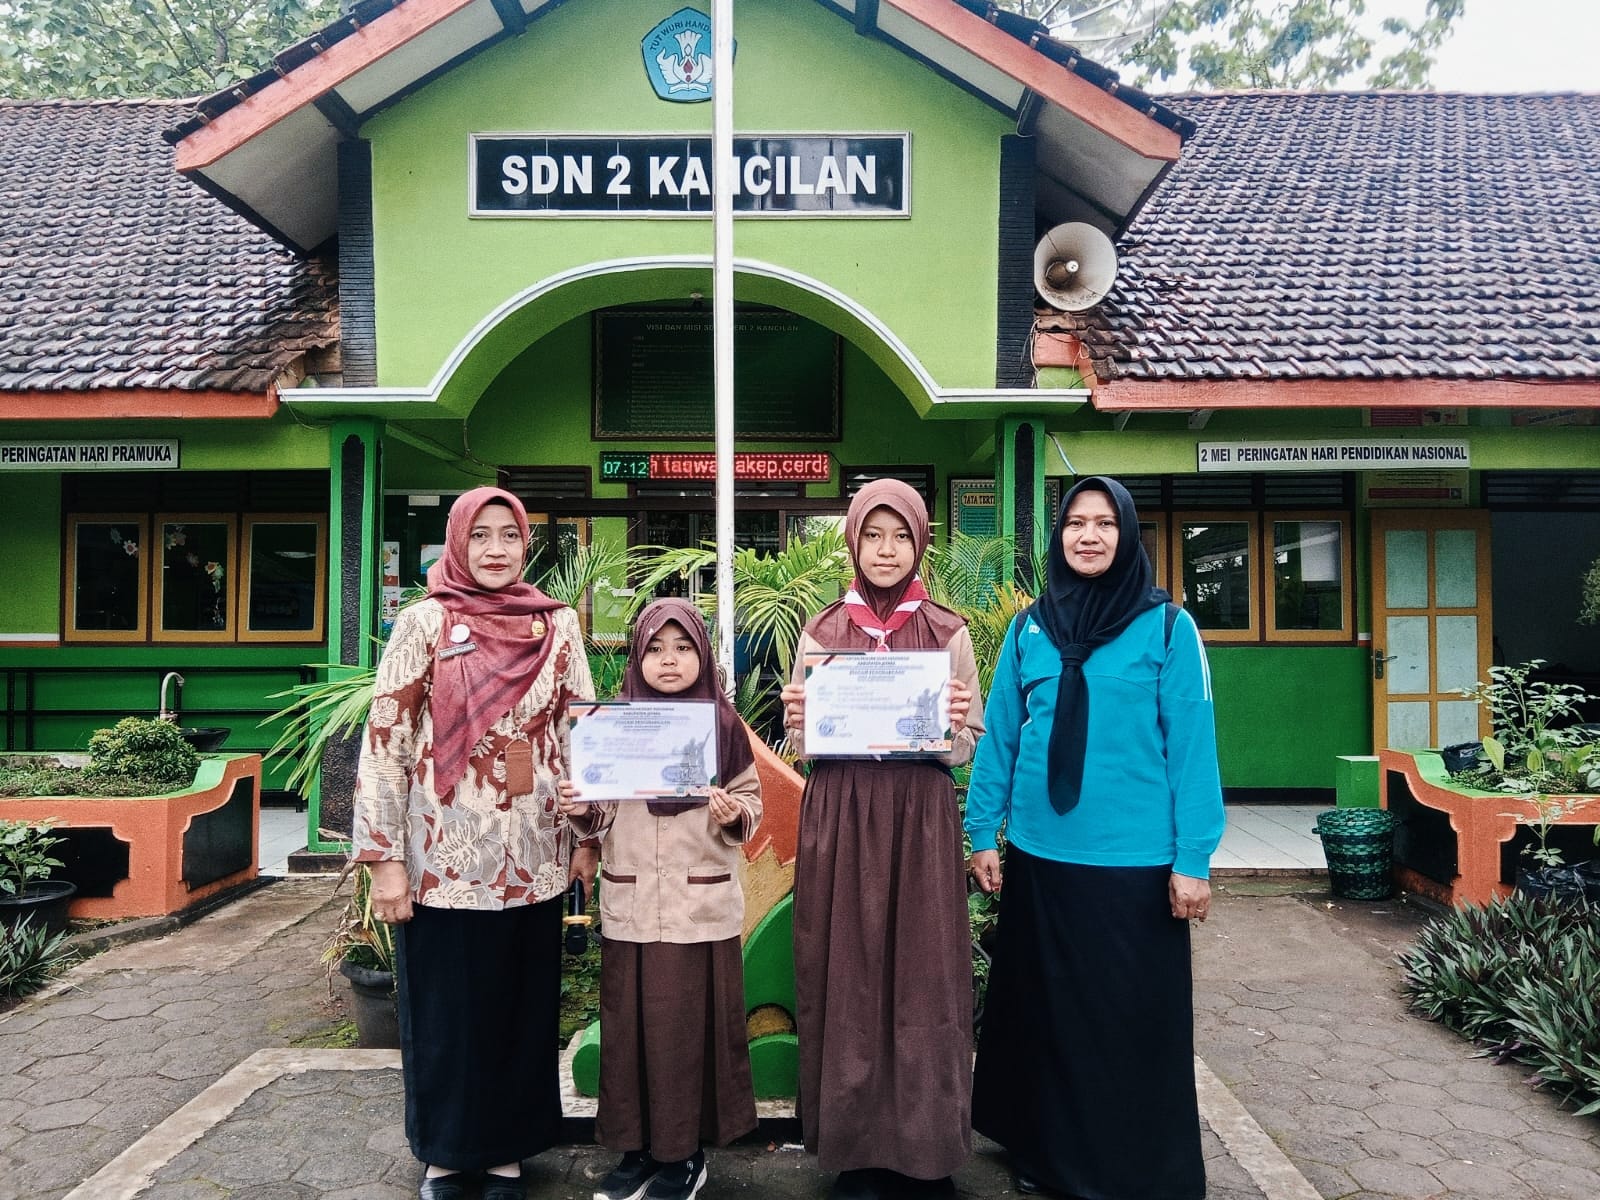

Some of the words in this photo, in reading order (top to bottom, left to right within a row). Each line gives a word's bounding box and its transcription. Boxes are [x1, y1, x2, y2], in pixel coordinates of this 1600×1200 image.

[650, 34, 663, 51] TUT
[661, 21, 683, 36] WURI
[685, 20, 711, 33] HAND
[501, 155, 593, 195] SDN
[606, 155, 632, 195] 2
[1, 446, 76, 463] PERINGATAN
[80, 446, 108, 462] HARI
[112, 446, 172, 461] PRAMUKA
[1201, 449, 1208, 462] 2
[1211, 448, 1231, 462] MEI
[1237, 448, 1308, 462] PERINGATAN
[1311, 447, 1337, 460] HARI
[1341, 447, 1409, 460] PENDIDIKAN
[1412, 447, 1467, 460] NASIONAL
[603, 461, 647, 474] 07:12
[963, 495, 977, 505] TATA
